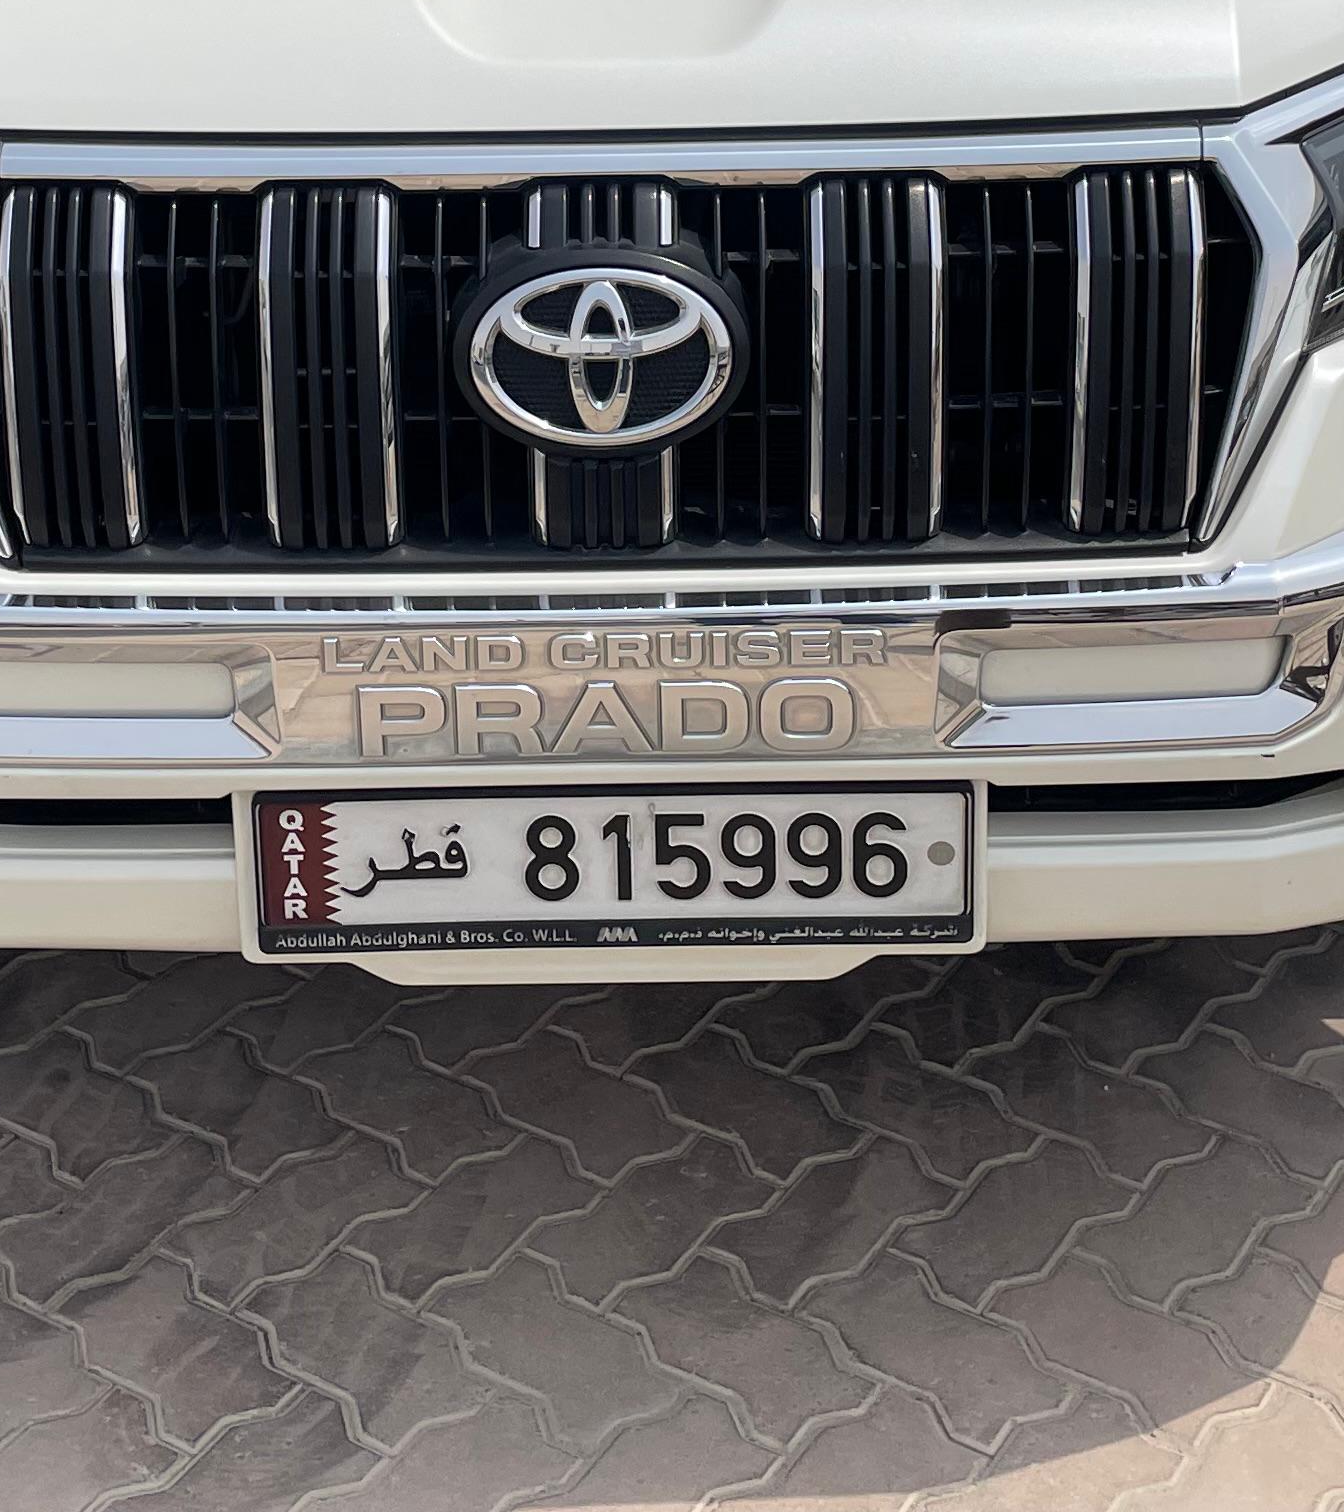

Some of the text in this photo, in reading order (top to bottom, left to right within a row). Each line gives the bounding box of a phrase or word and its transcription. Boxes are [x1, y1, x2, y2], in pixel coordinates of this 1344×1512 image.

[322, 627, 888, 675] LAND CRUISER
[356, 677, 856, 759] PRADO
[278, 809, 309, 920] QATAR
[339, 823, 469, 898] قطر
[524, 811, 909, 902] 815996
[275, 934, 346, 949] Abdullah
[350, 931, 442, 948] Abdulghani
[445, 931, 456, 944] &
